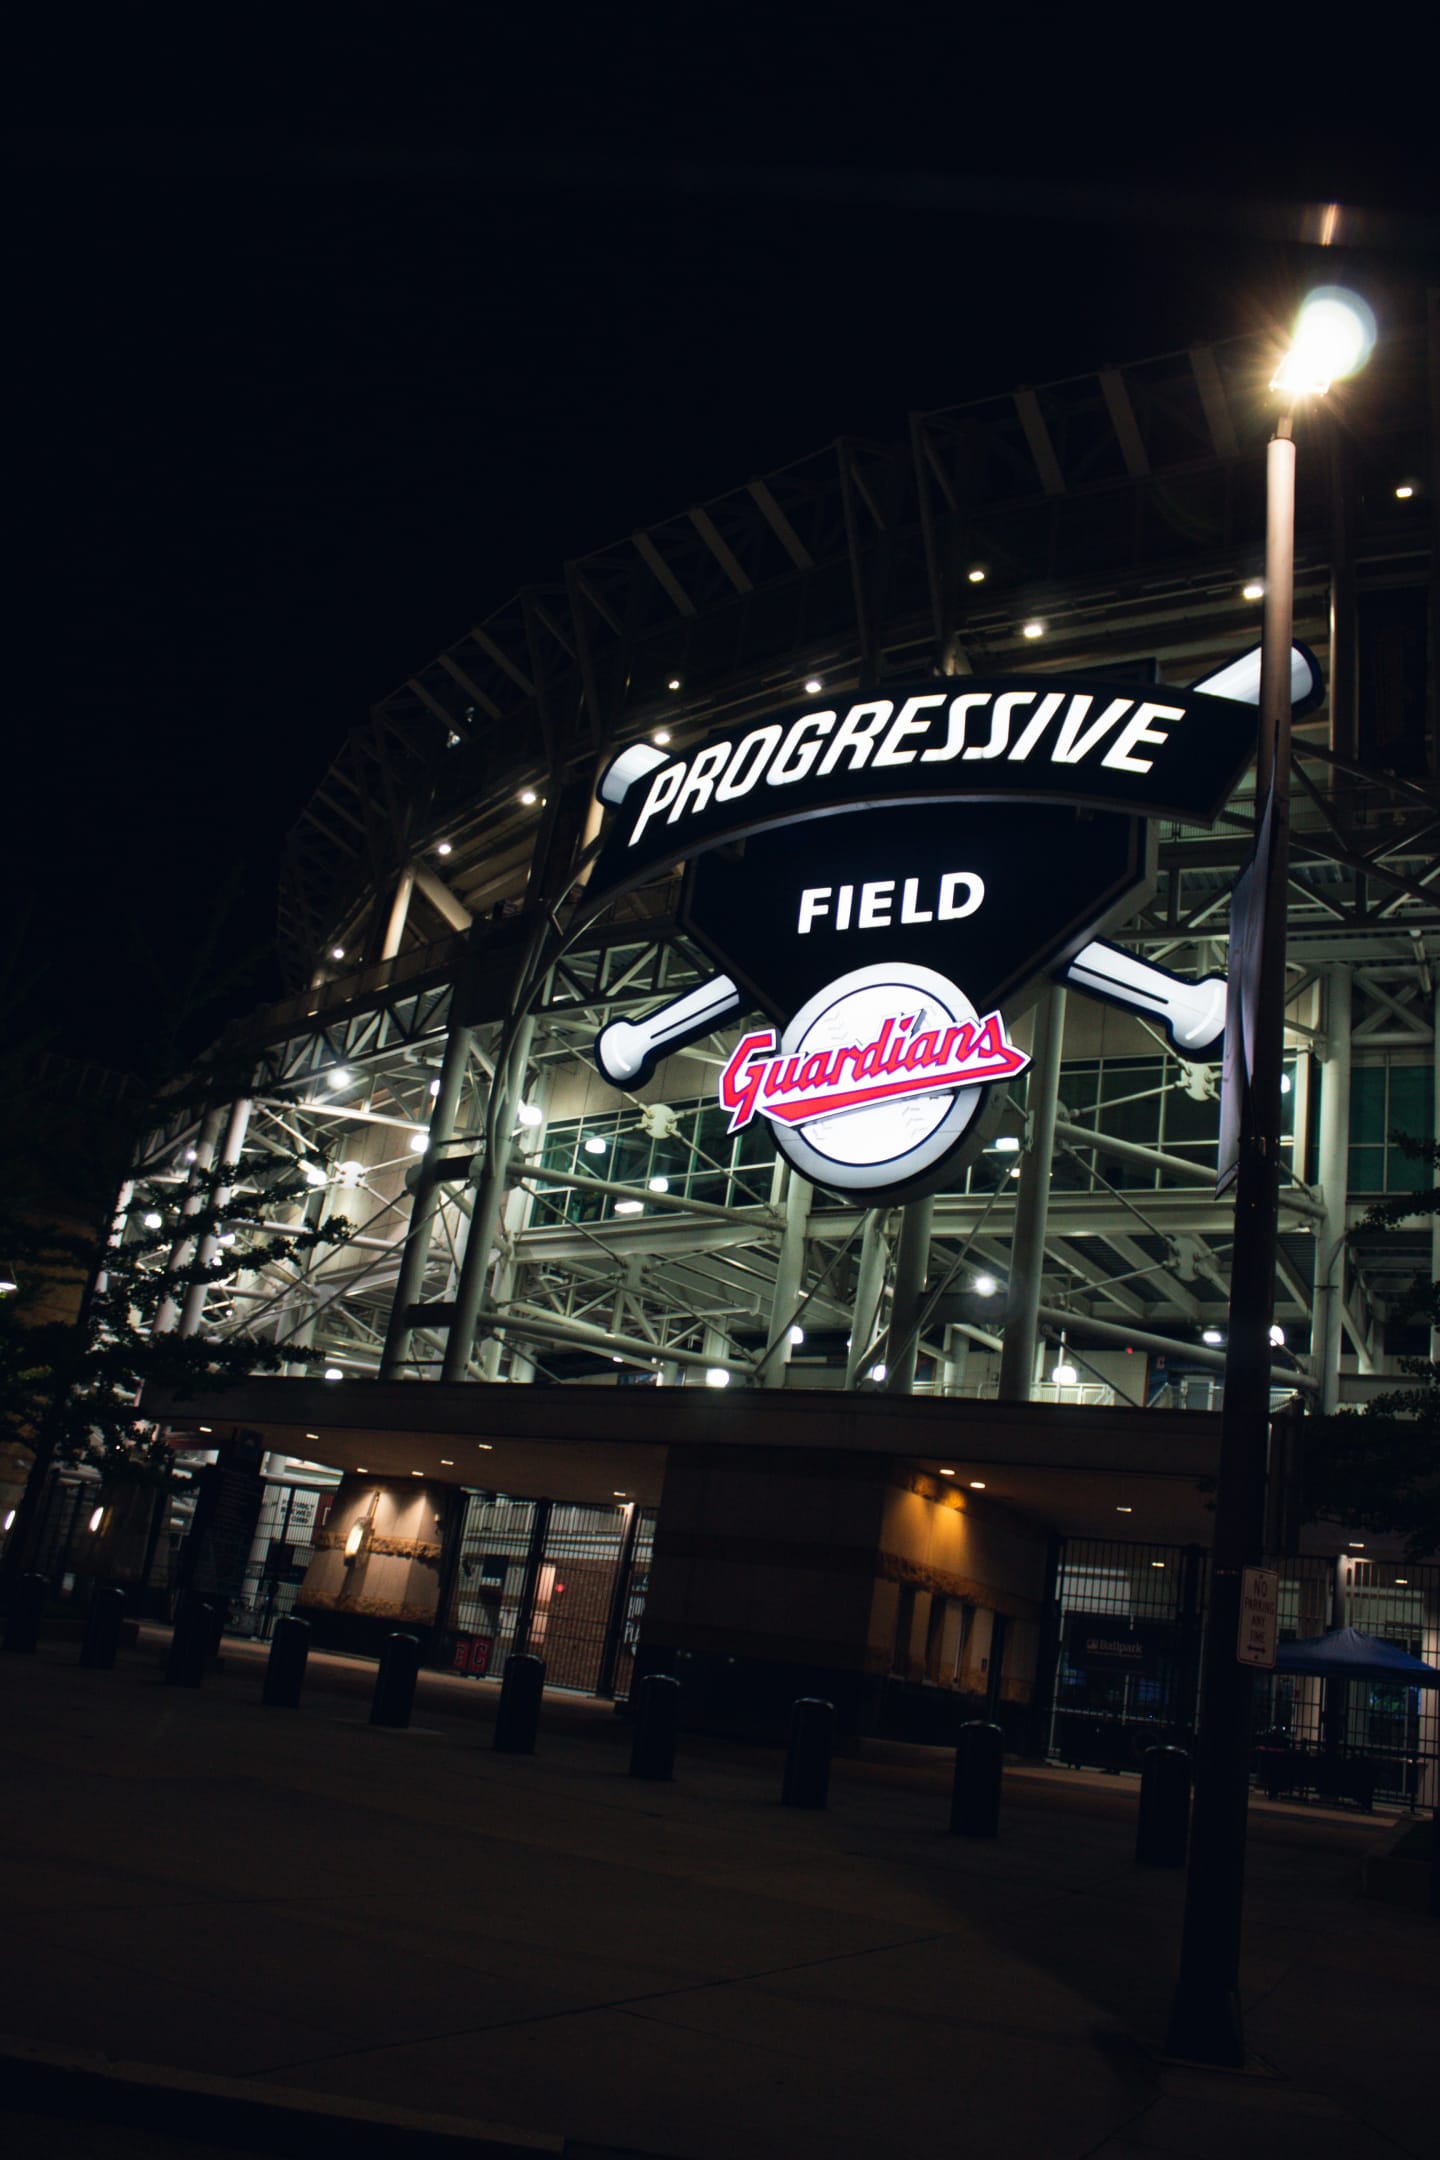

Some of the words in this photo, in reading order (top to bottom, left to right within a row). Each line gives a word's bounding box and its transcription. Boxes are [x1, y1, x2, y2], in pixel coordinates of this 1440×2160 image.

[628, 691, 1186, 848] PROGRESSIVE
[796, 871, 986, 935] FIELD
[720, 1010, 1028, 1134] Guardians
[1253, 1579, 1268, 1598] NO
[1244, 1598, 1275, 1616] PARKING
[1250, 1615, 1265, 1627] ANY
[1249, 1629, 1265, 1643] TIME
